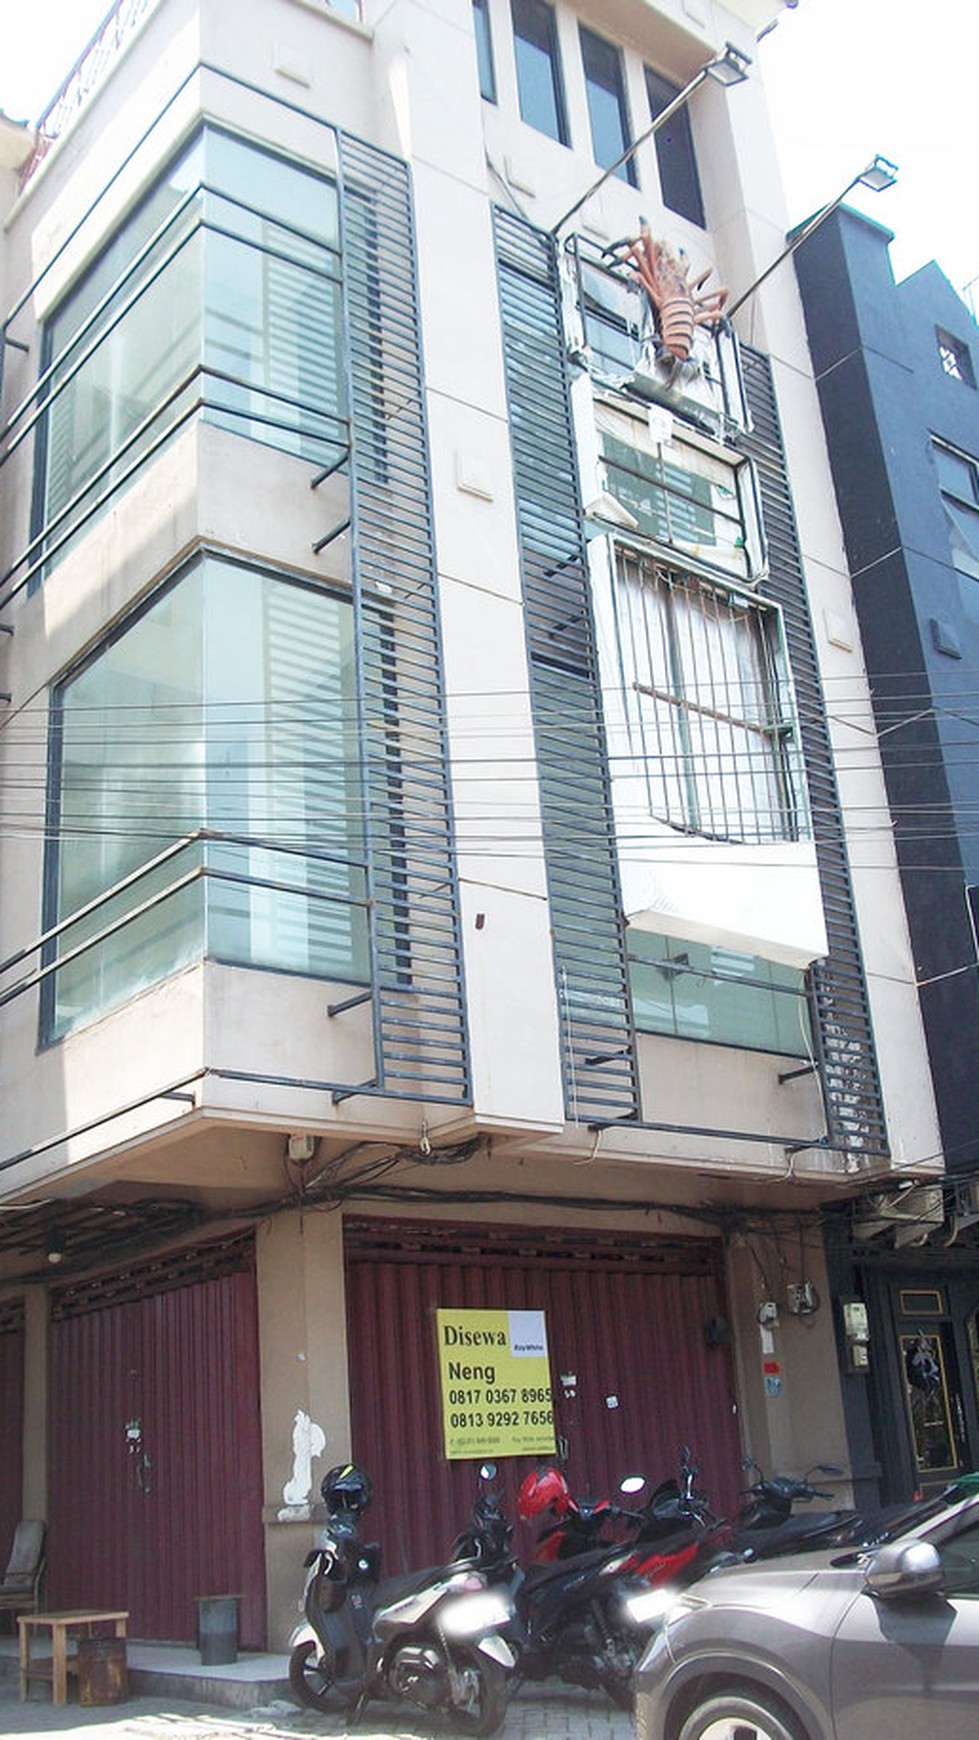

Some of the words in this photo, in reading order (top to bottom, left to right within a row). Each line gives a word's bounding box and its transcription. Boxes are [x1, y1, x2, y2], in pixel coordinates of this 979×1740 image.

[443, 1325, 507, 1346] Disewa
[448, 1361, 496, 1385] Neng
[449, 1390, 481, 1405] 0817
[485, 1389, 517, 1404] 0367
[521, 1388, 552, 1403] 8965
[450, 1413, 484, 1428] 0813
[487, 1412, 519, 1427] 9292
[524, 1410, 554, 1426] 7656
